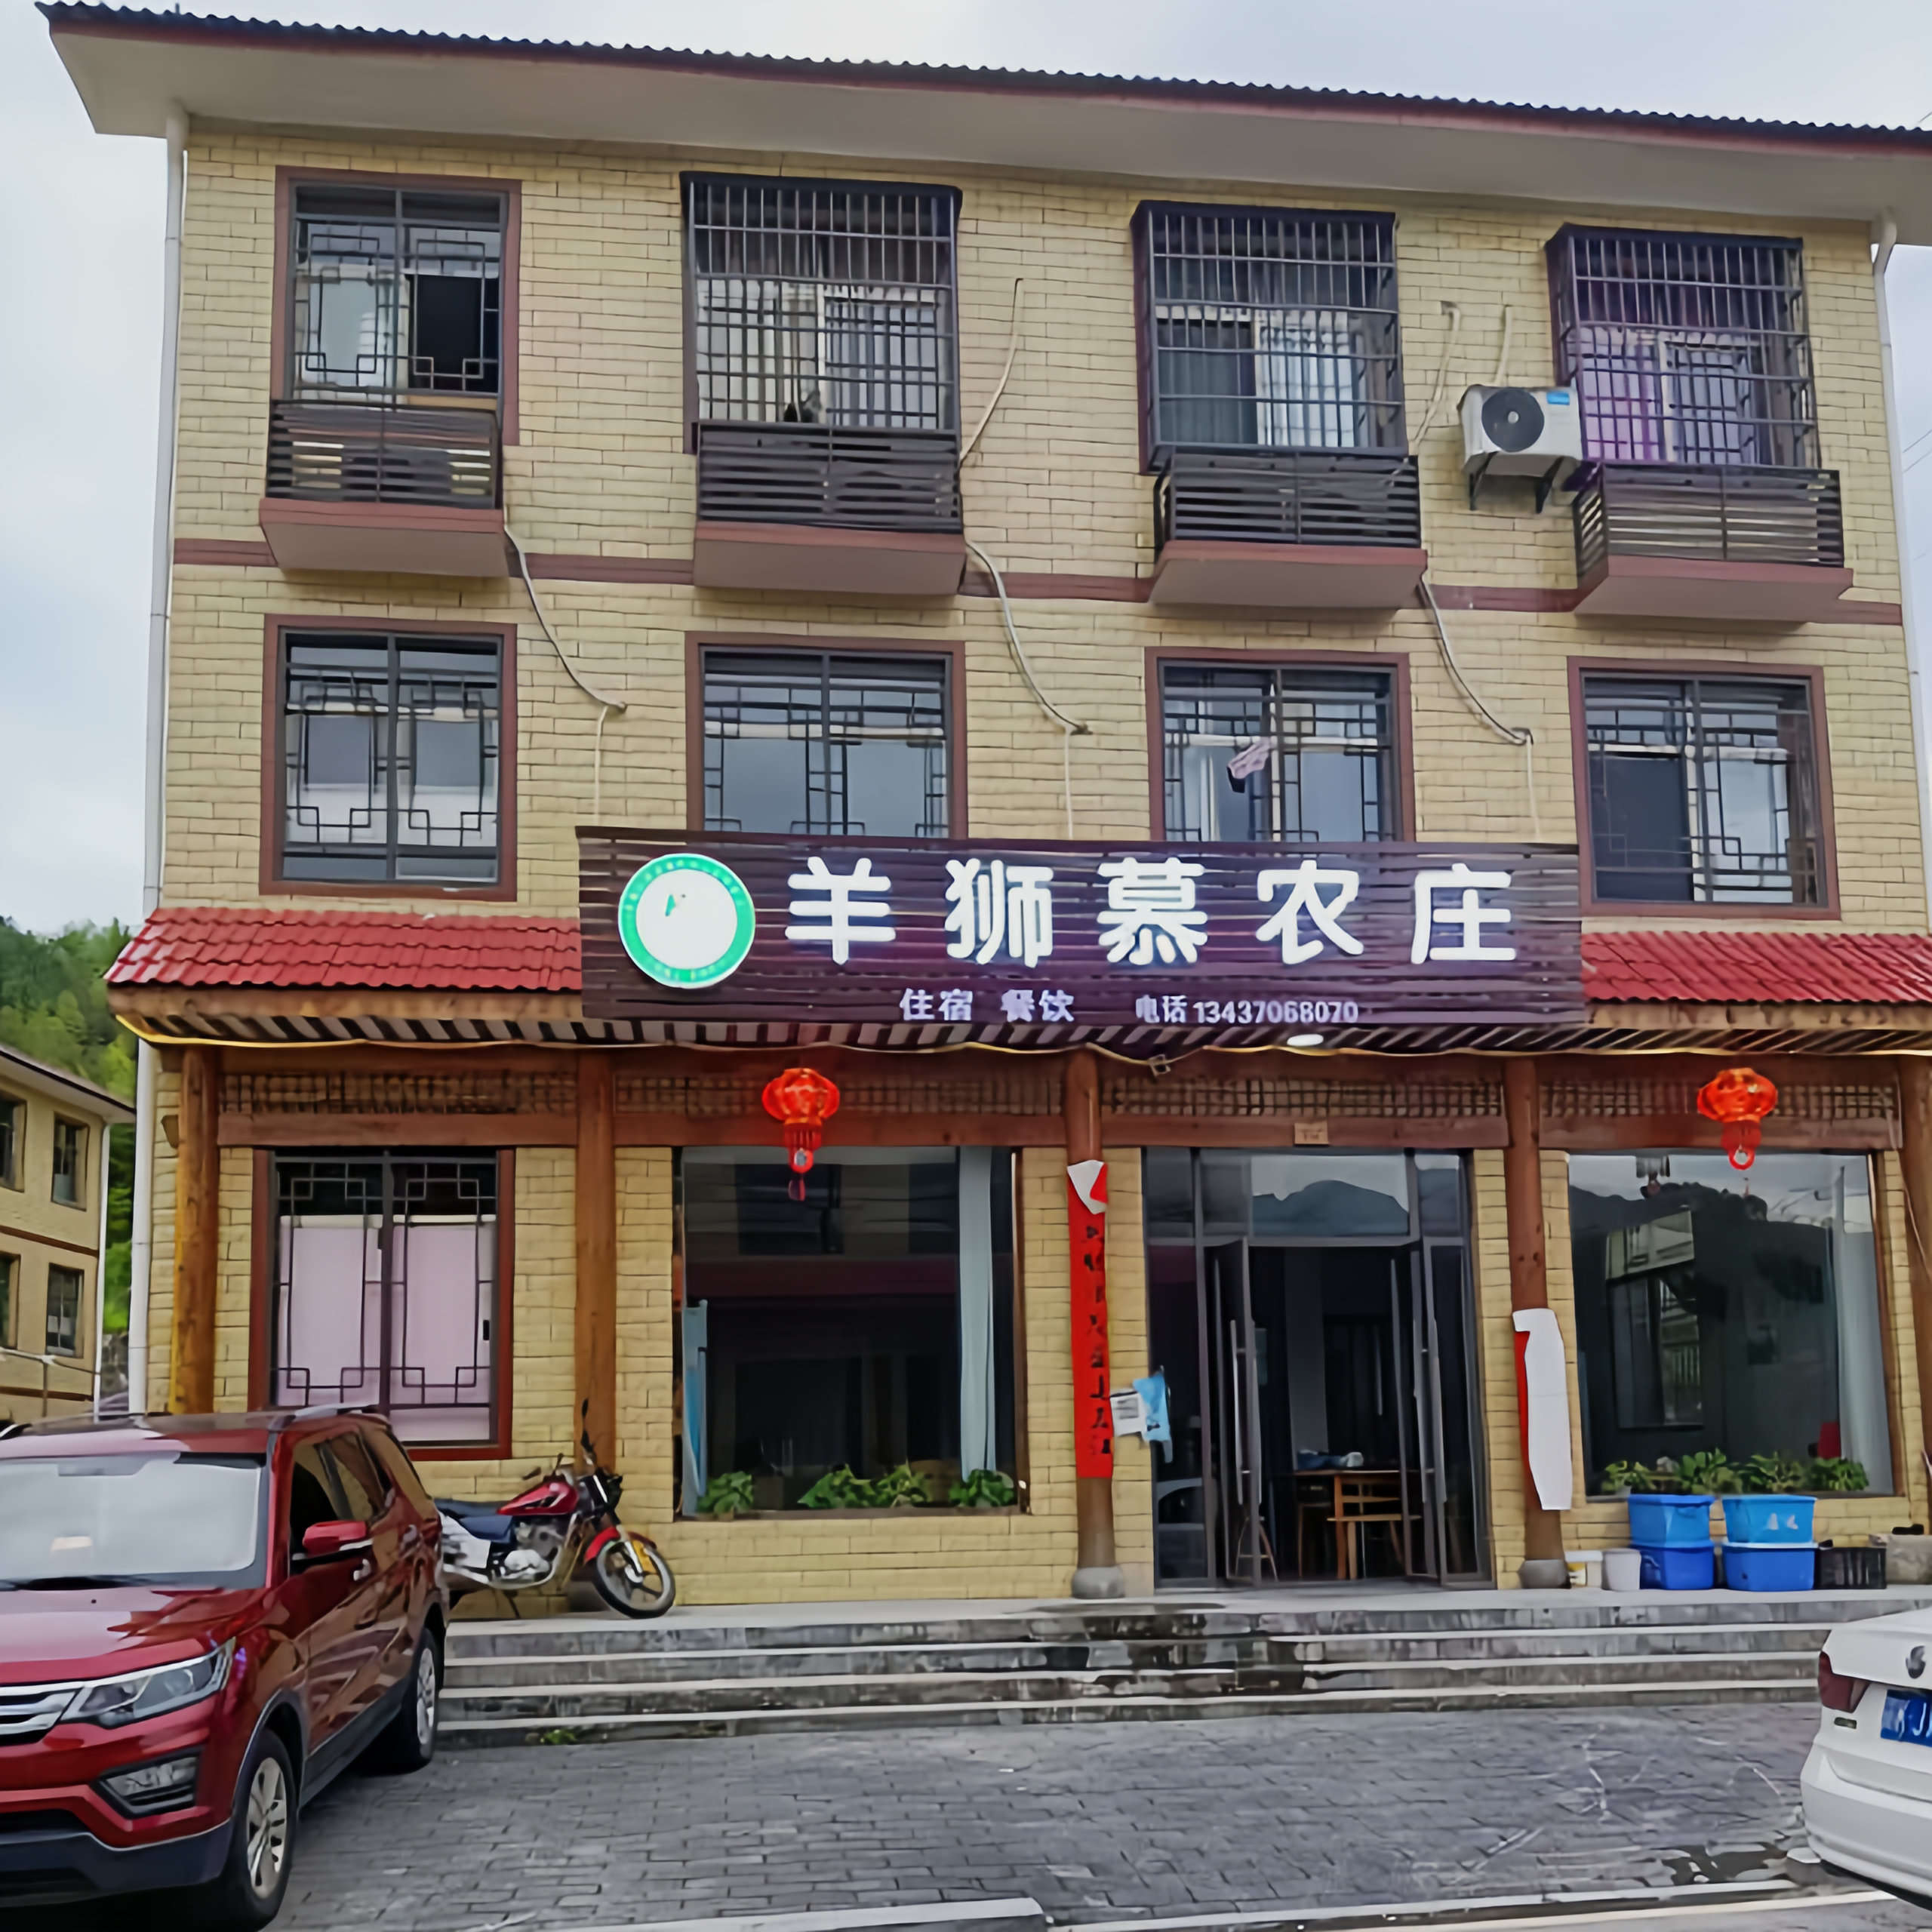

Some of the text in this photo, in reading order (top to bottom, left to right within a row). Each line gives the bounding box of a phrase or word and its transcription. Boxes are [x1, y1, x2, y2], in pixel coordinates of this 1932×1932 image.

[784, 856, 1516, 968] 羊狮慕农庄
[900, 988, 973, 1021] 住宿
[1135, 994, 1187, 1023] 电话
[1192, 1000, 1358, 1023] 13437068070
